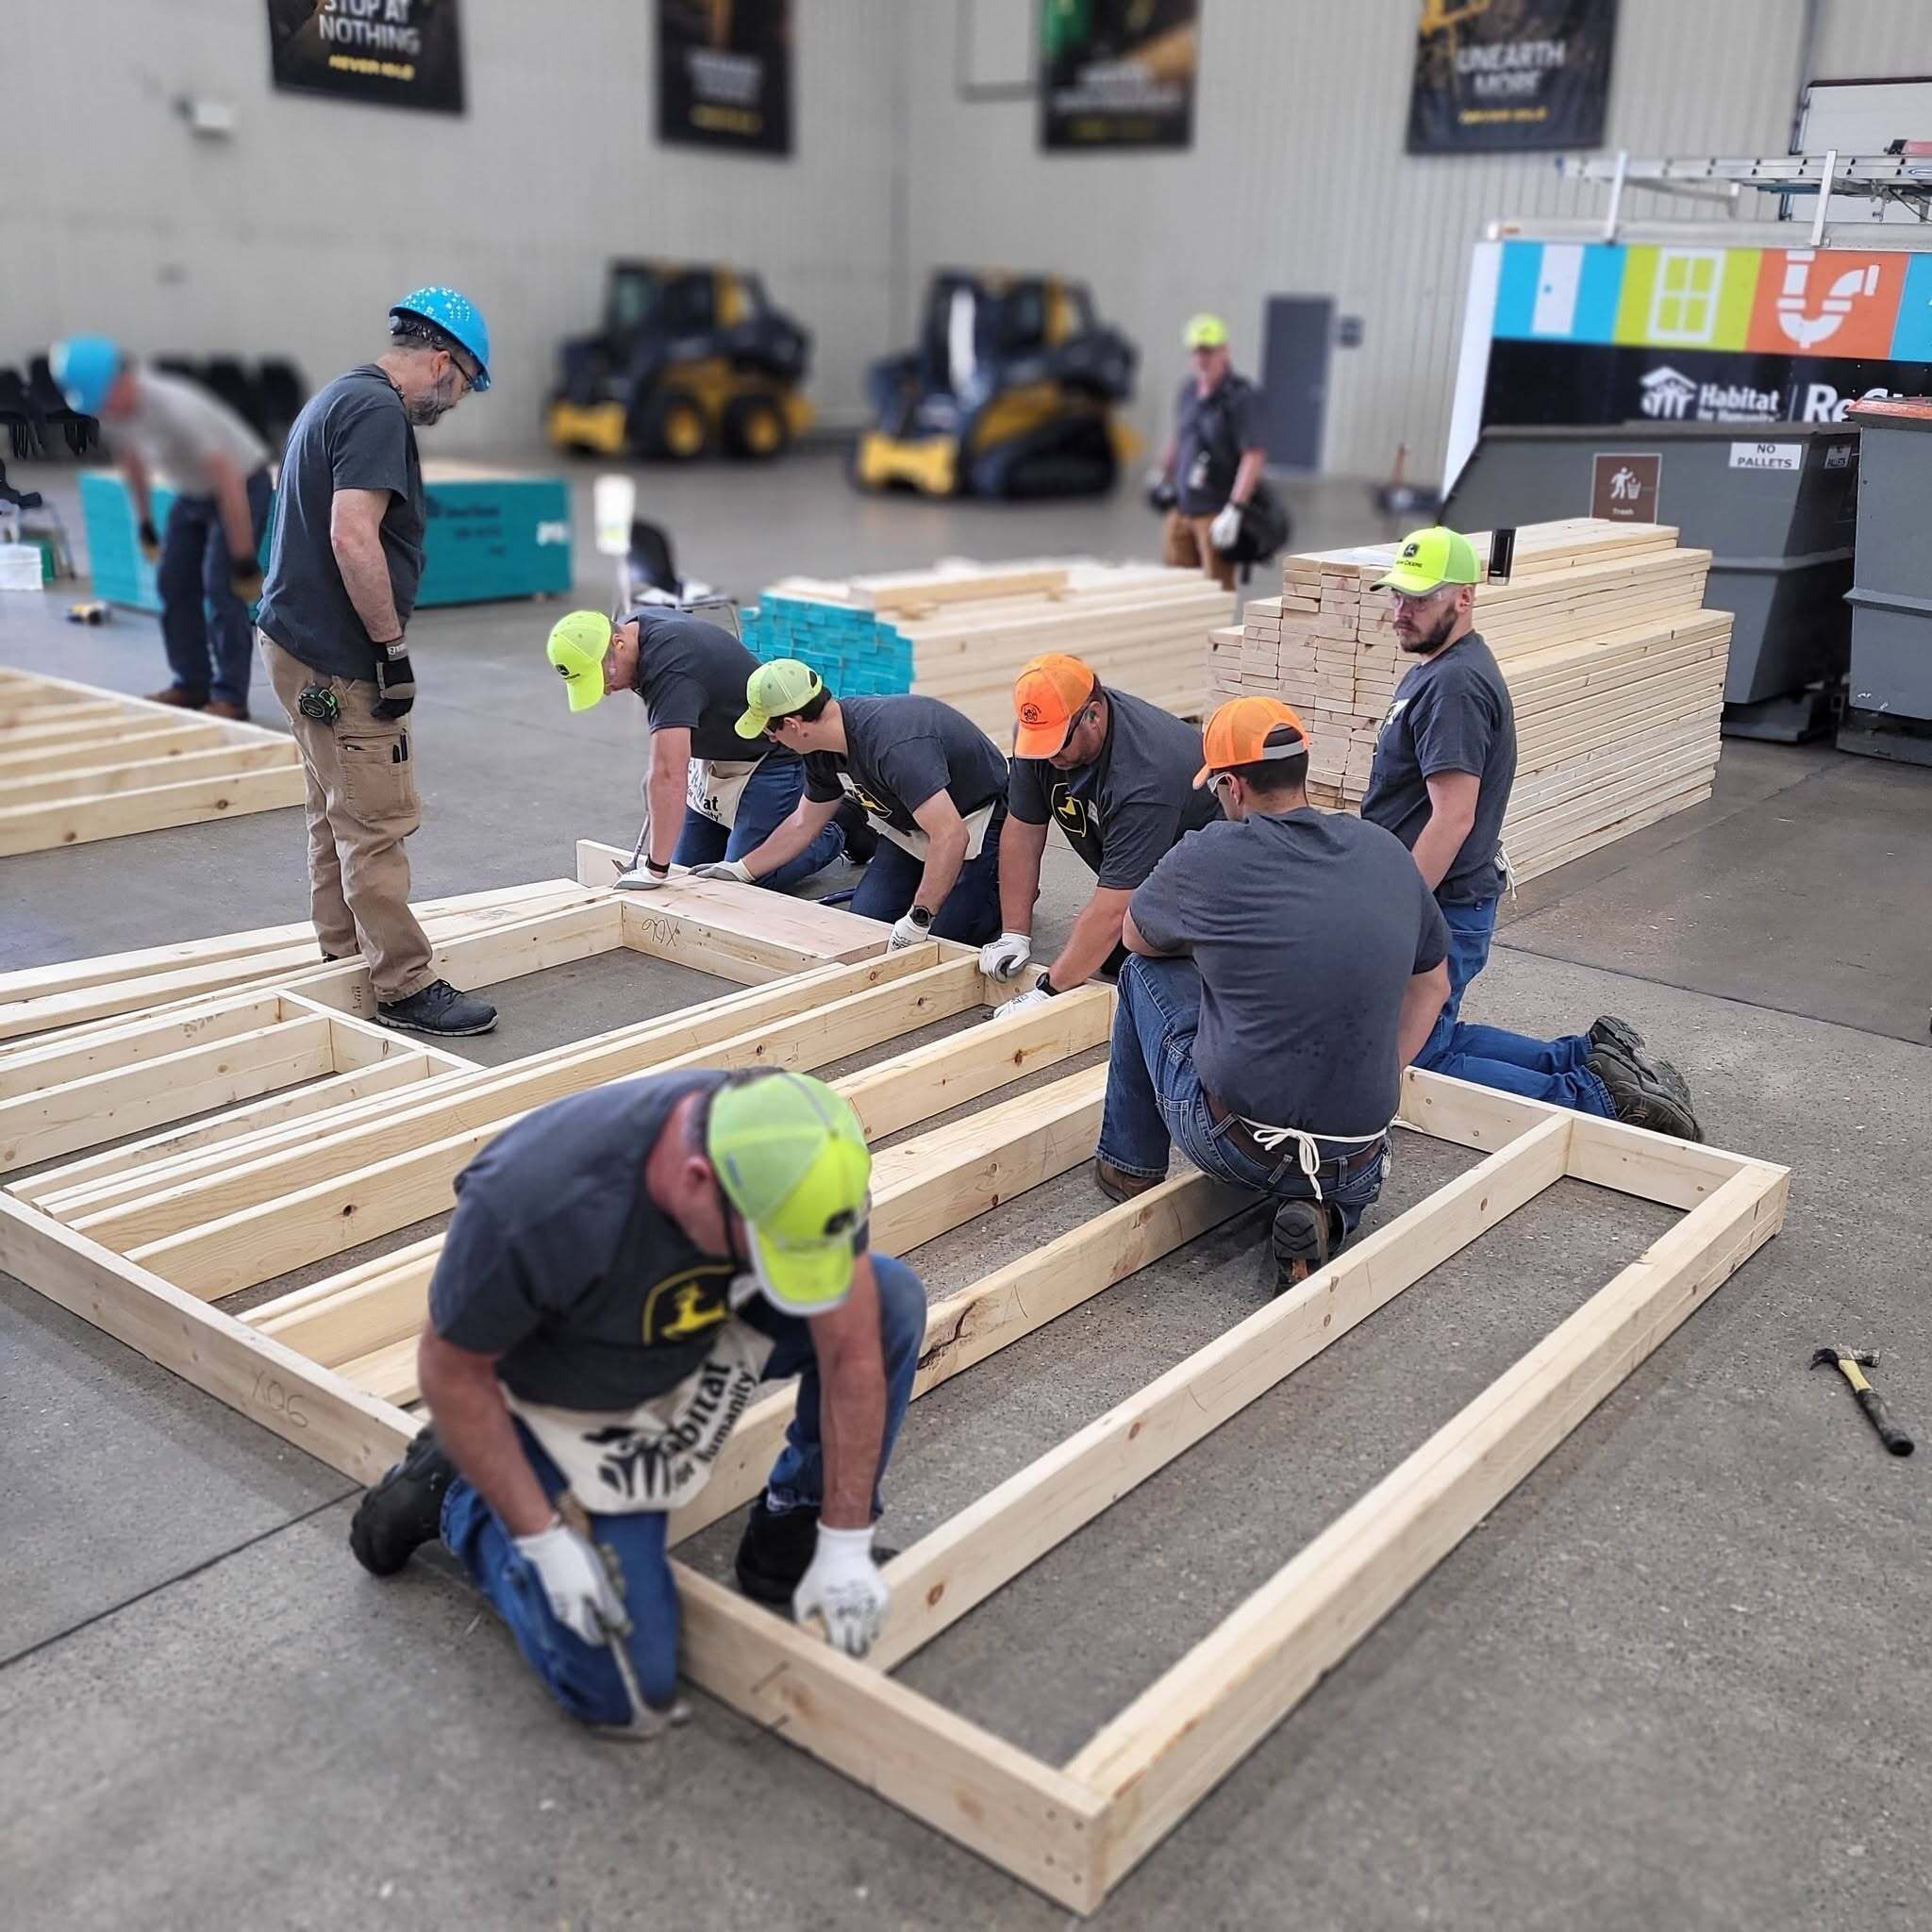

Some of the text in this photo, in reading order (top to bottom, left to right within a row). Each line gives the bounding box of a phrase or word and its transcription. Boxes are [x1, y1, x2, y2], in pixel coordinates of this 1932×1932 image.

[319, 14, 422, 55] NOTHING
[1456, 40, 1565, 74] UNEARTH
[1474, 71, 1540, 96] MORE
[1699, 383, 1779, 411] Habitat
[1757, 443, 1775, 454] NO
[1738, 457, 1793, 468] PALLETS
